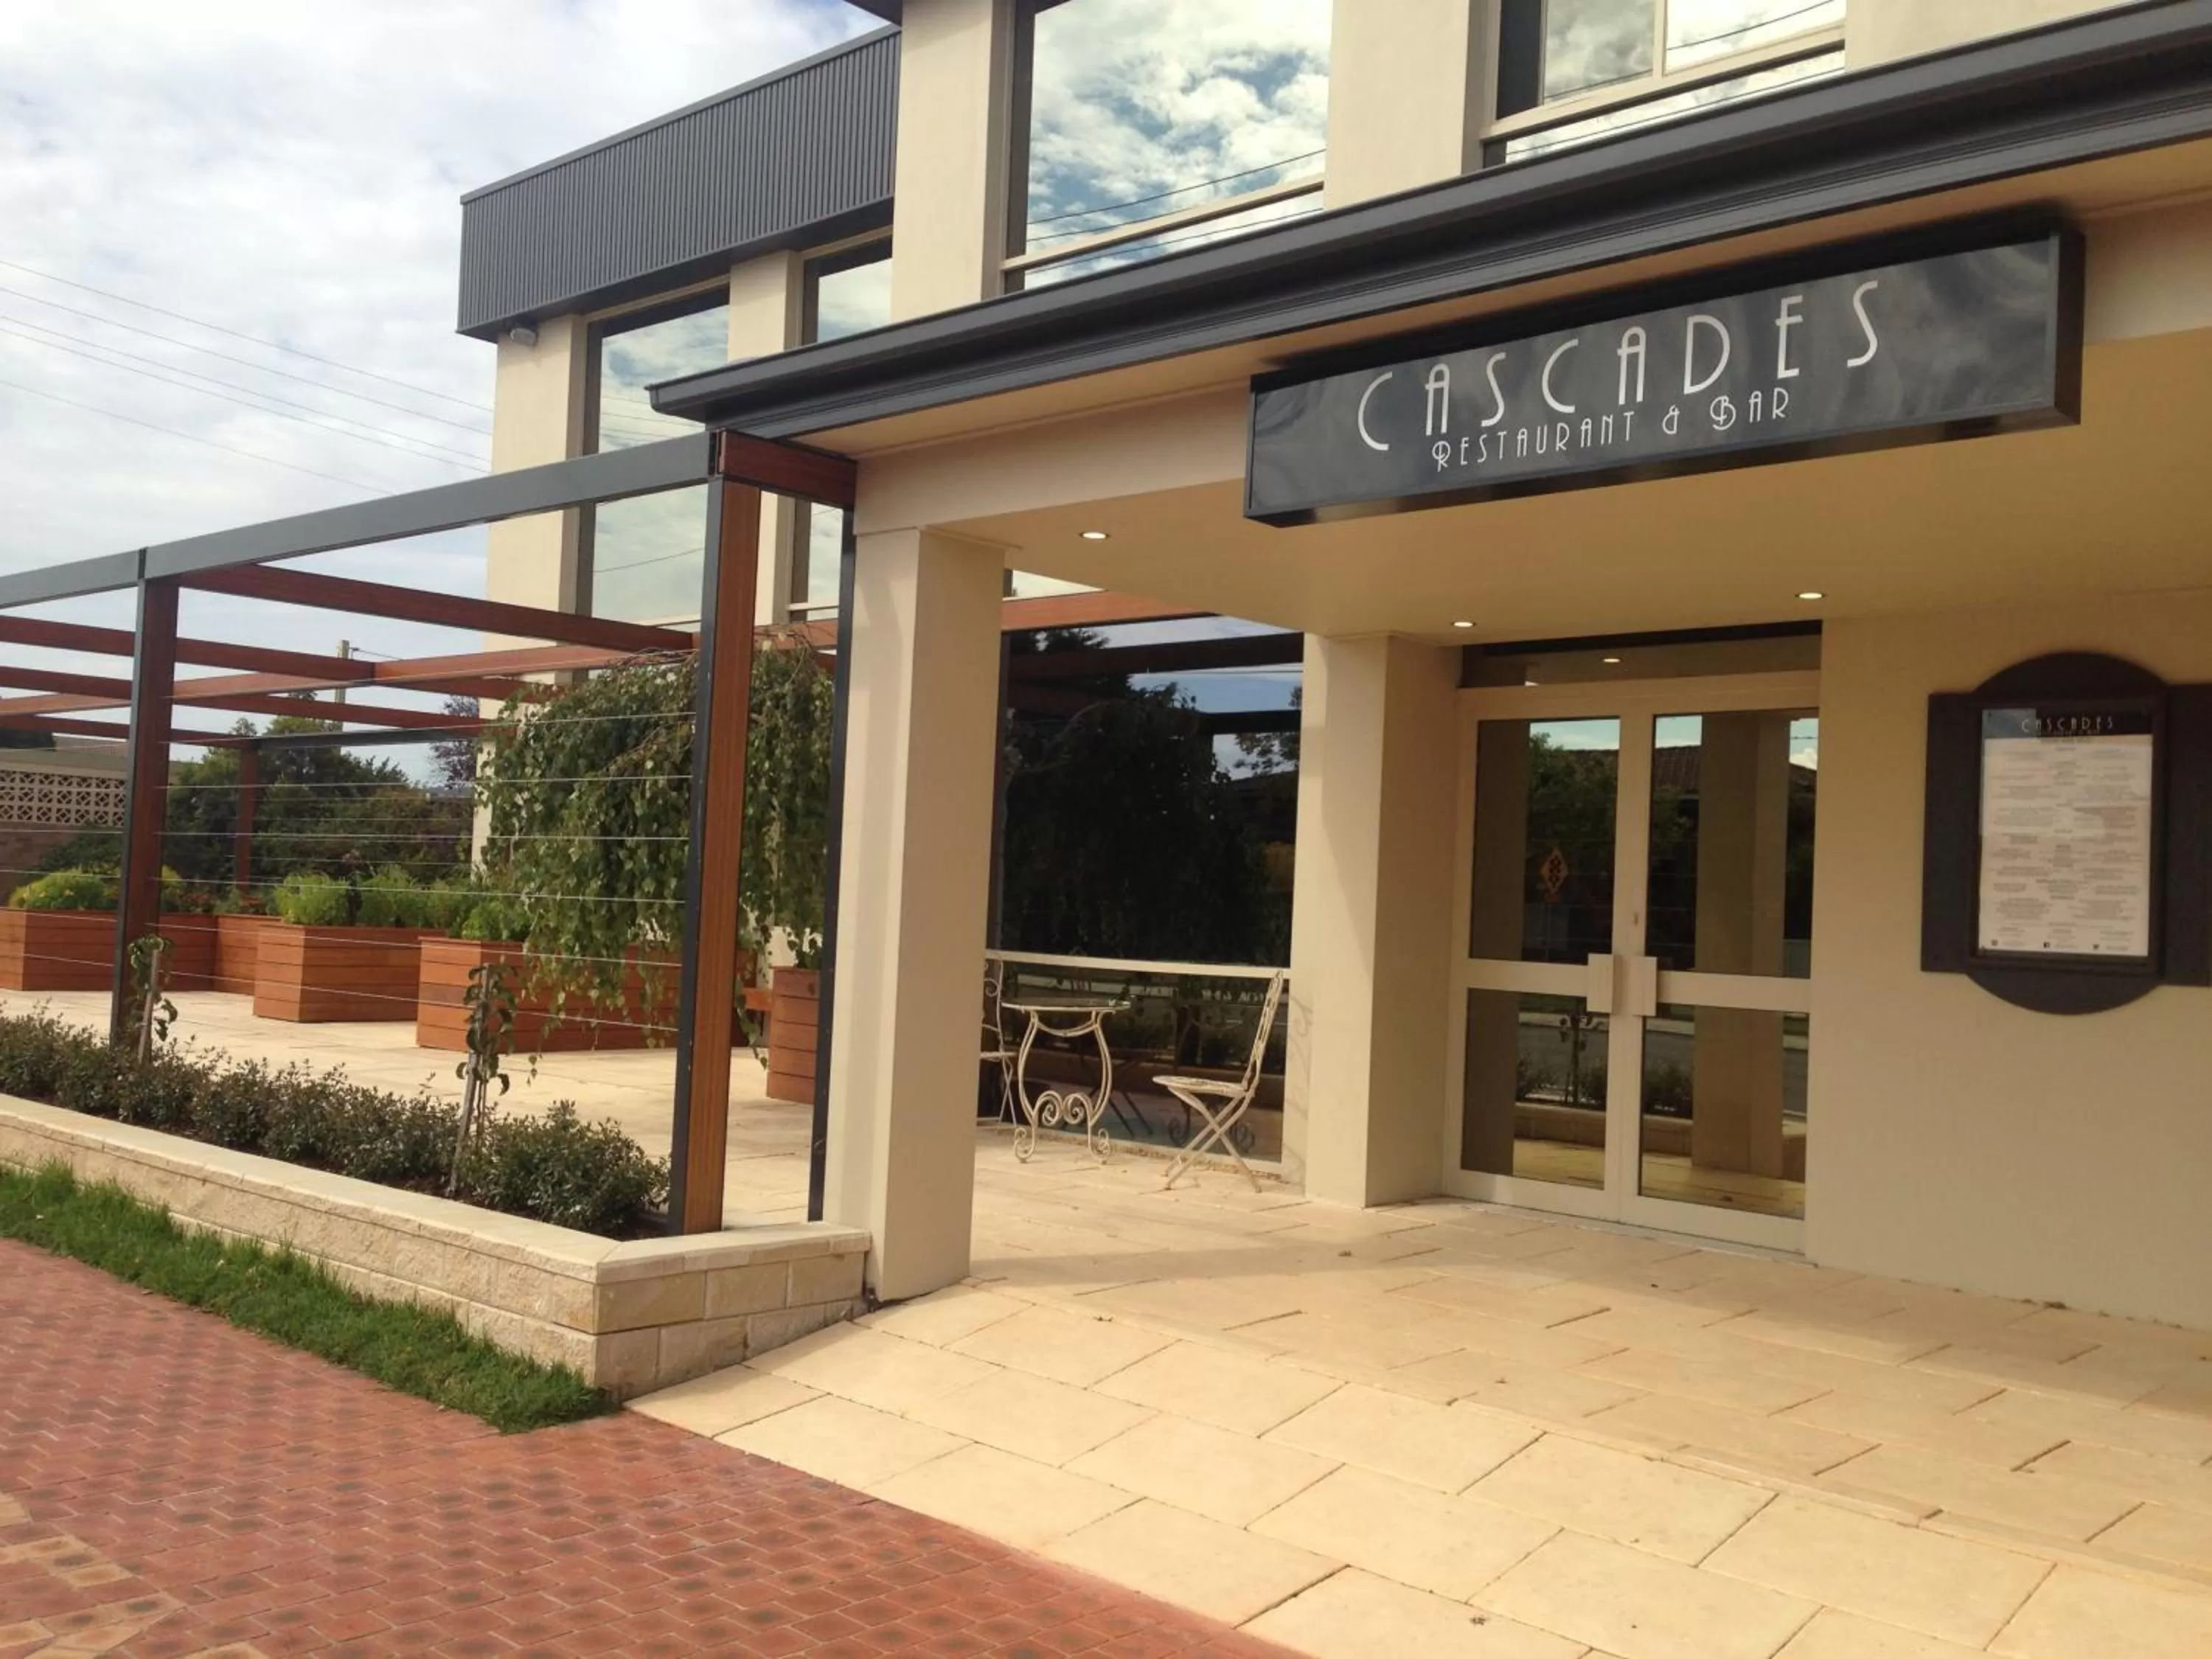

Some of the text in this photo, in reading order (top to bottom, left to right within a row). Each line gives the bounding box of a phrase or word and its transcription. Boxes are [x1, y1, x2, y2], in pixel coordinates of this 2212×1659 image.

[1357, 281, 1879, 451] CASCADES
[1432, 387, 1790, 473] RESTAURANT & BAR
